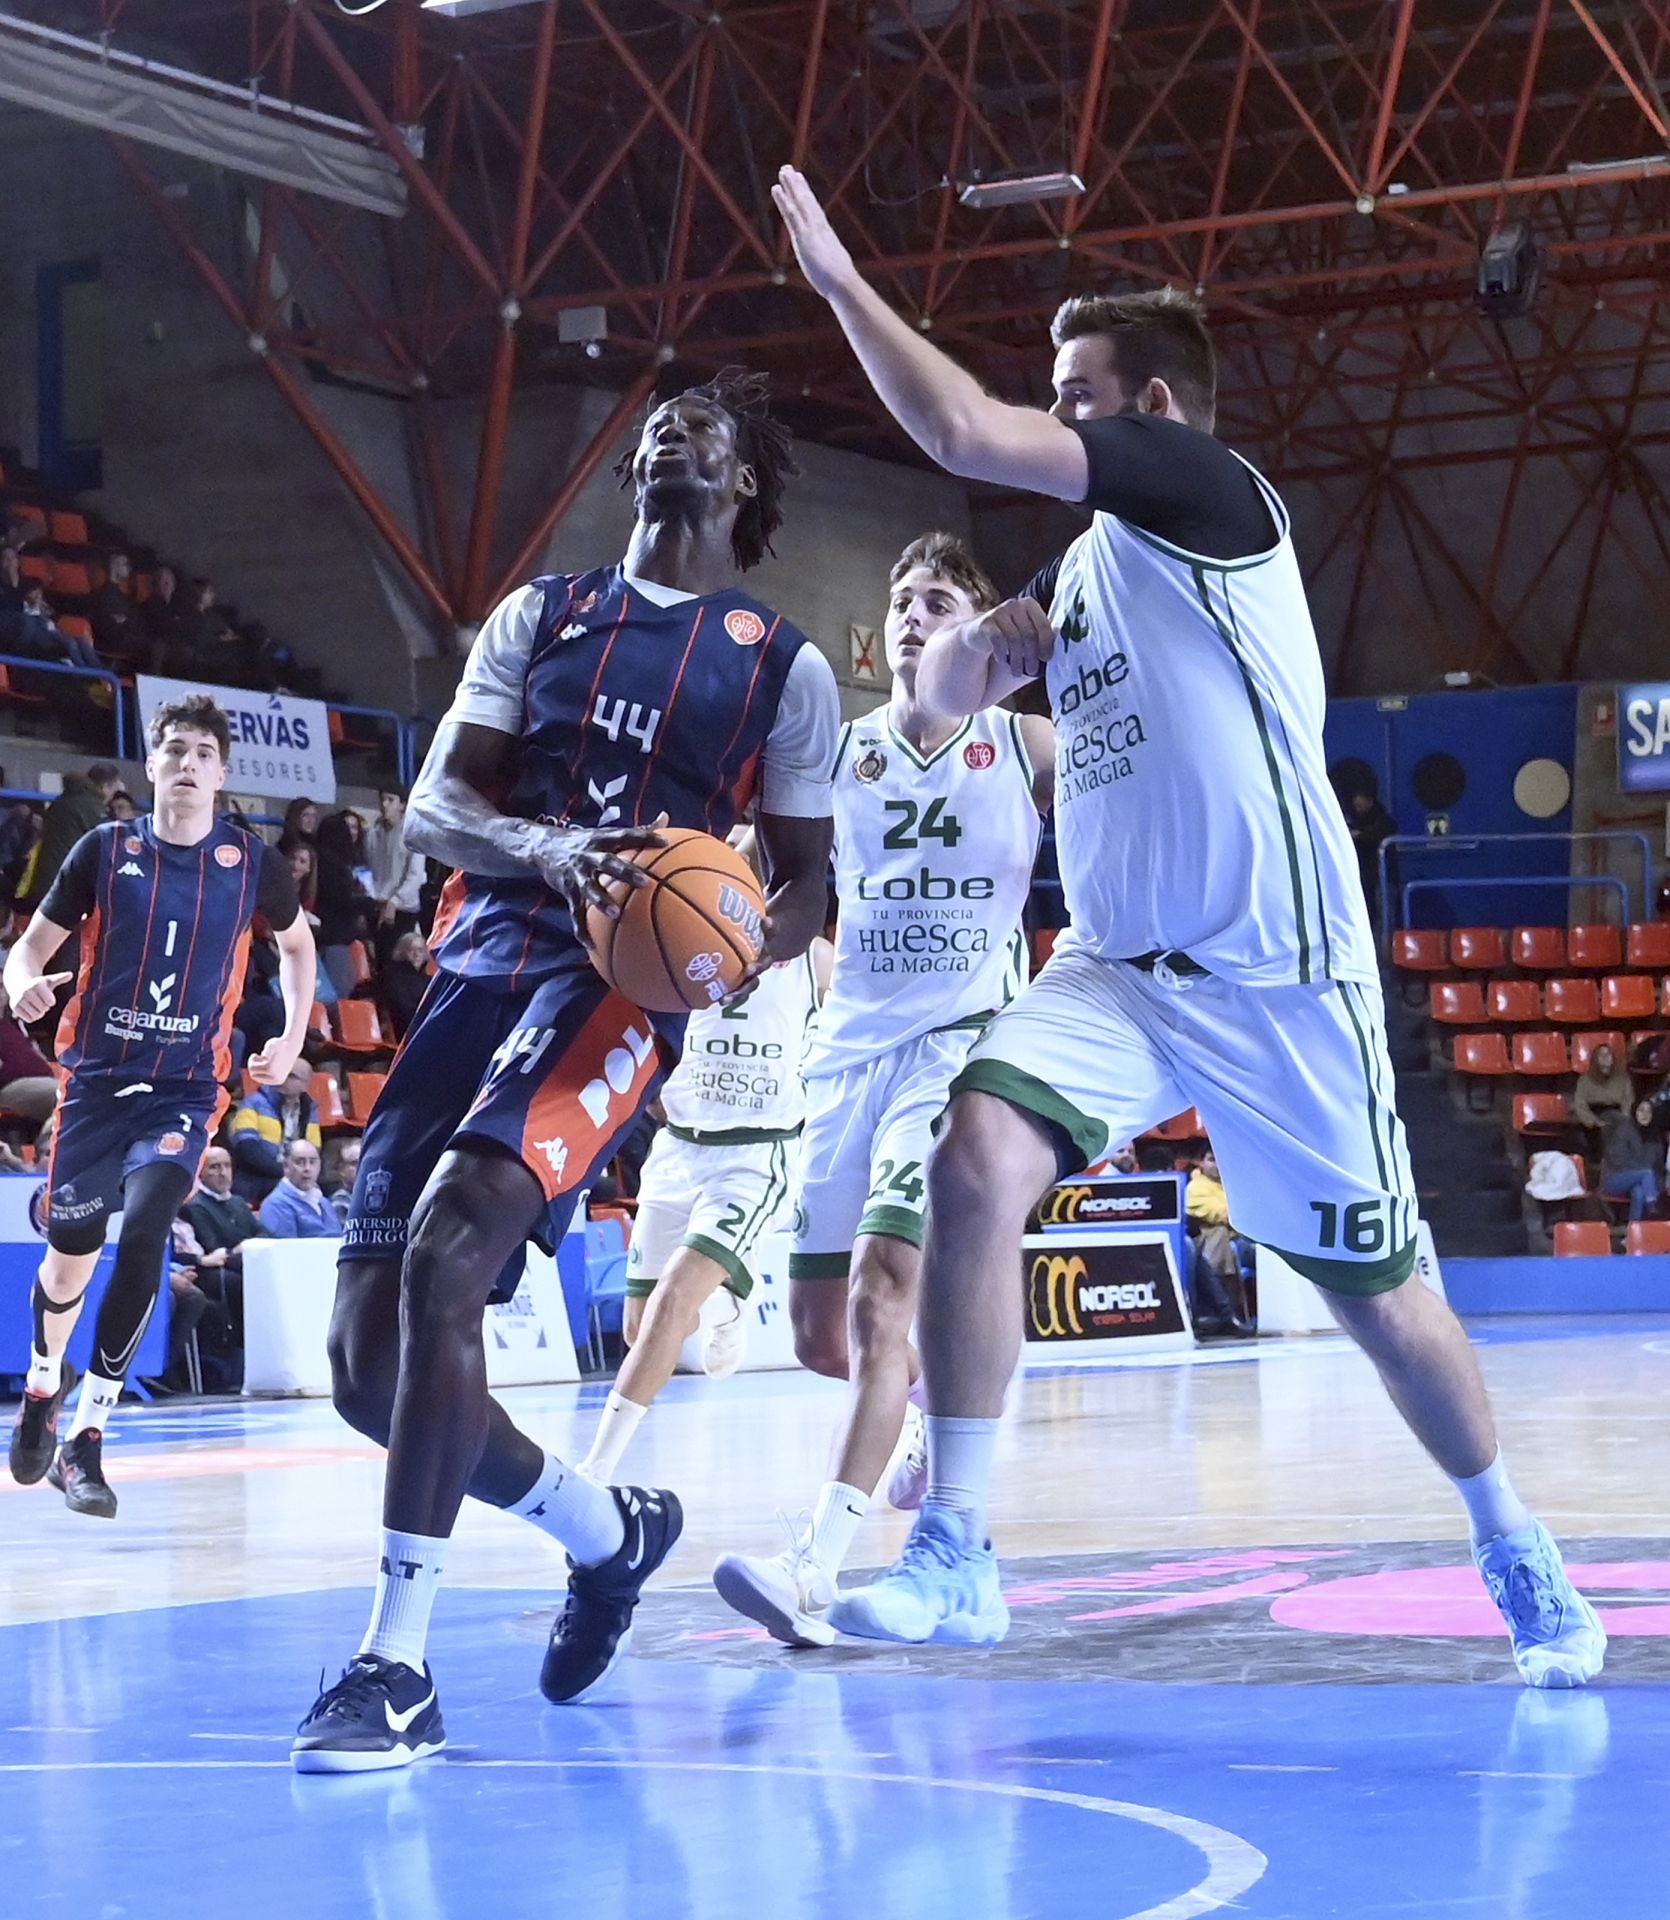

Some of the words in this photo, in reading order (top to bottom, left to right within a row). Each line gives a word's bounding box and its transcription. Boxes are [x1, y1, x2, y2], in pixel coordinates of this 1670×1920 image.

[592, 694, 661, 753] 44
[1058, 714, 1147, 778] uesca
[883, 797, 961, 850] 24
[858, 867, 995, 900] Lobe
[165, 920, 177, 957] 1
[492, 1026, 557, 1080] 44
[690, 1034, 782, 1059] Lobe
[868, 1159, 924, 1203] 24
[716, 1203, 747, 1237] 2
[1310, 1200, 1384, 1252] 16
[1079, 1281, 1161, 1312] NORSOL
